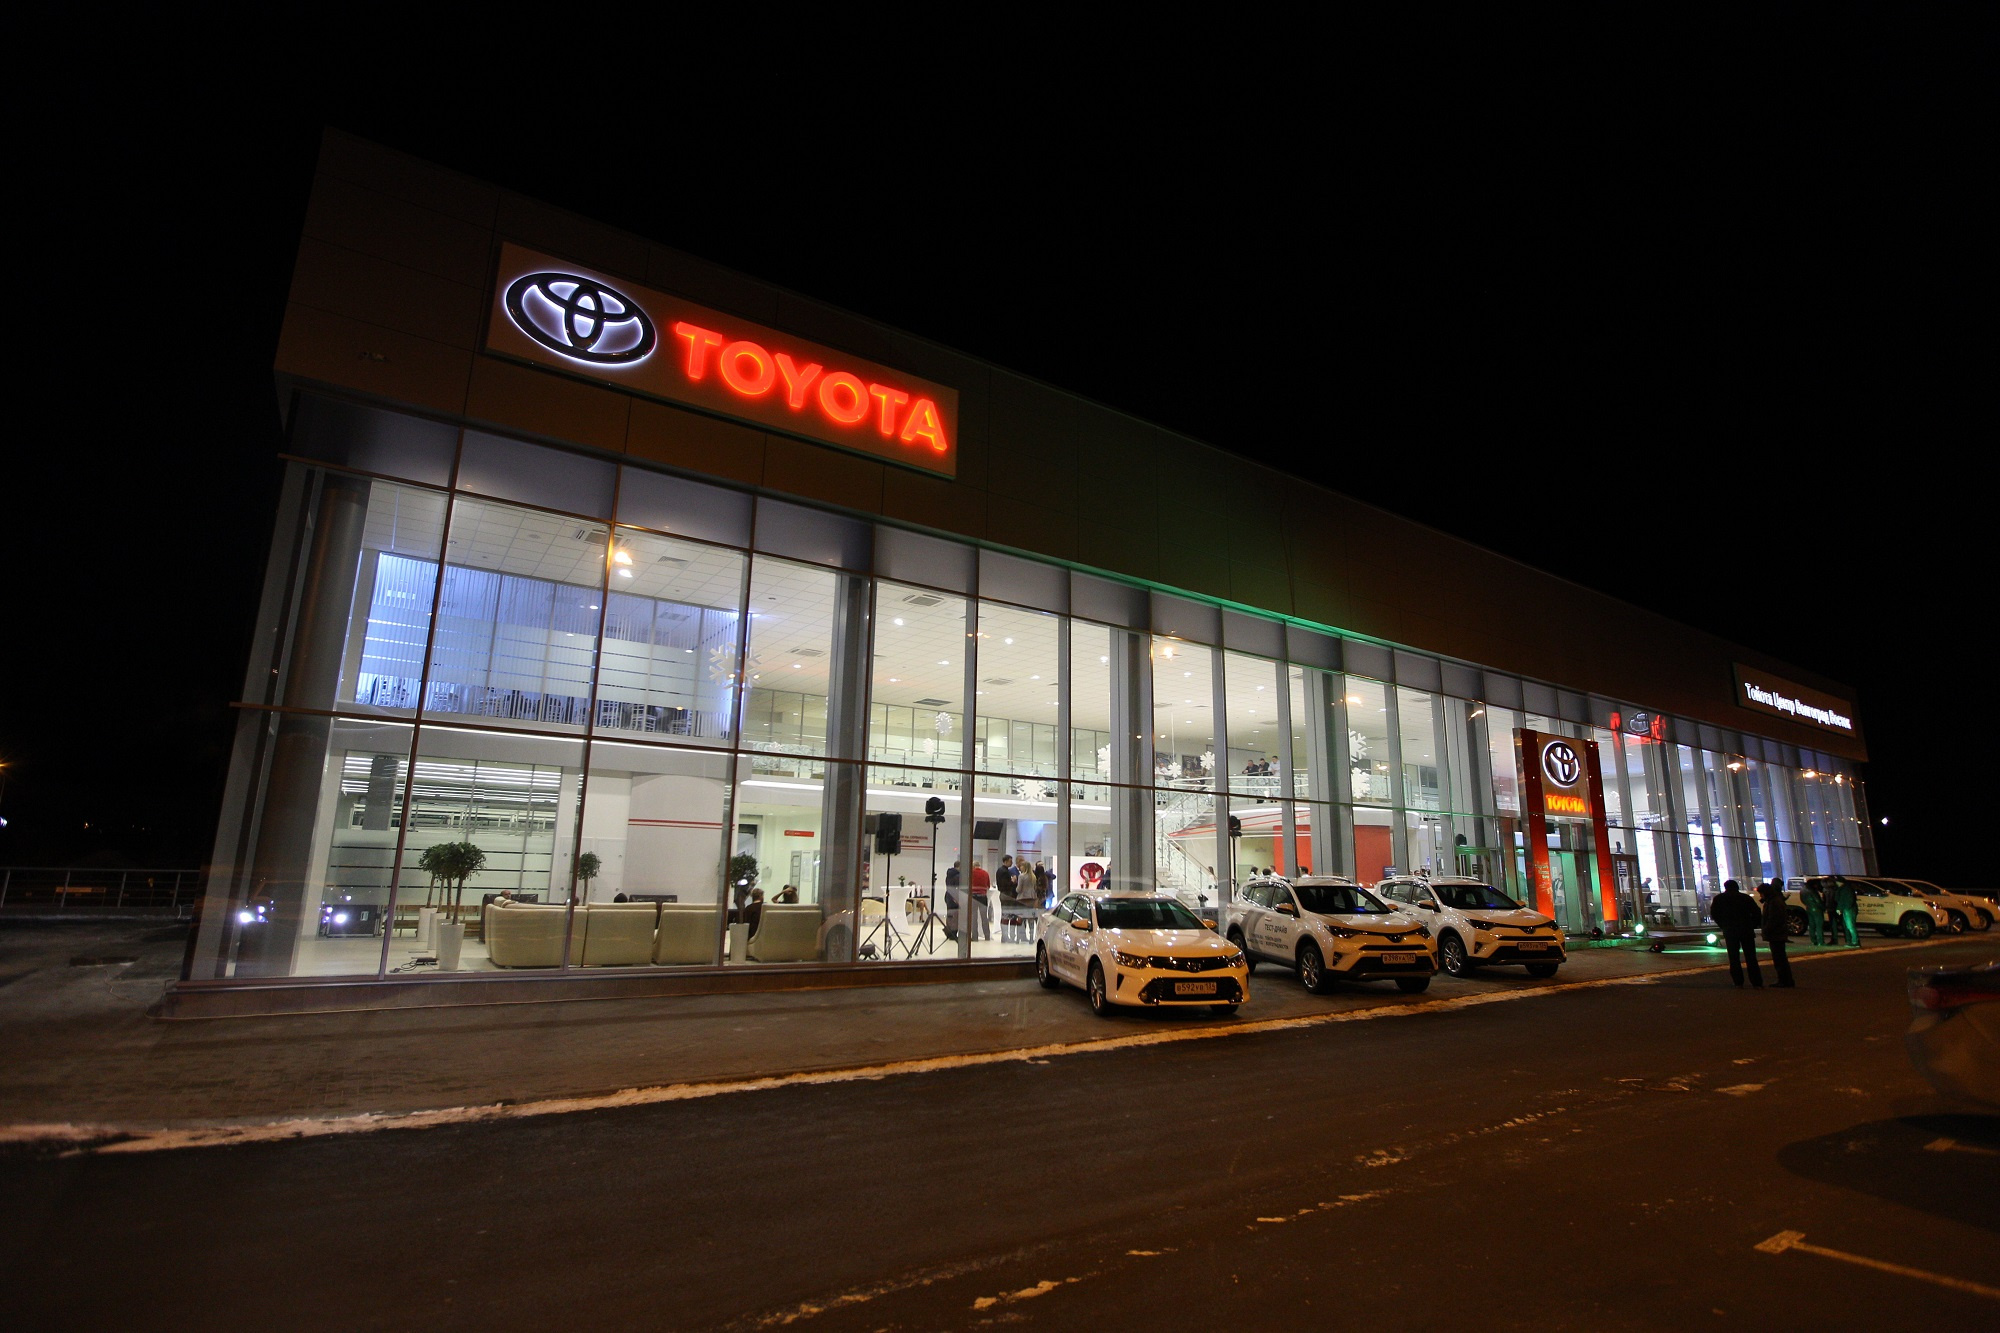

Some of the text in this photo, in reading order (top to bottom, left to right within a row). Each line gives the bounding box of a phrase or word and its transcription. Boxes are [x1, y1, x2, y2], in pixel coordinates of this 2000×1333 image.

[674, 320, 948, 452] TOYOTA
[1744, 682, 1773, 706] Тойота
[1773, 691, 1795, 716] Центр
[1546, 794, 1586, 813] TOYOTA
[1264, 923, 1288, 934] ТЕСТ-ДРАЙВ
